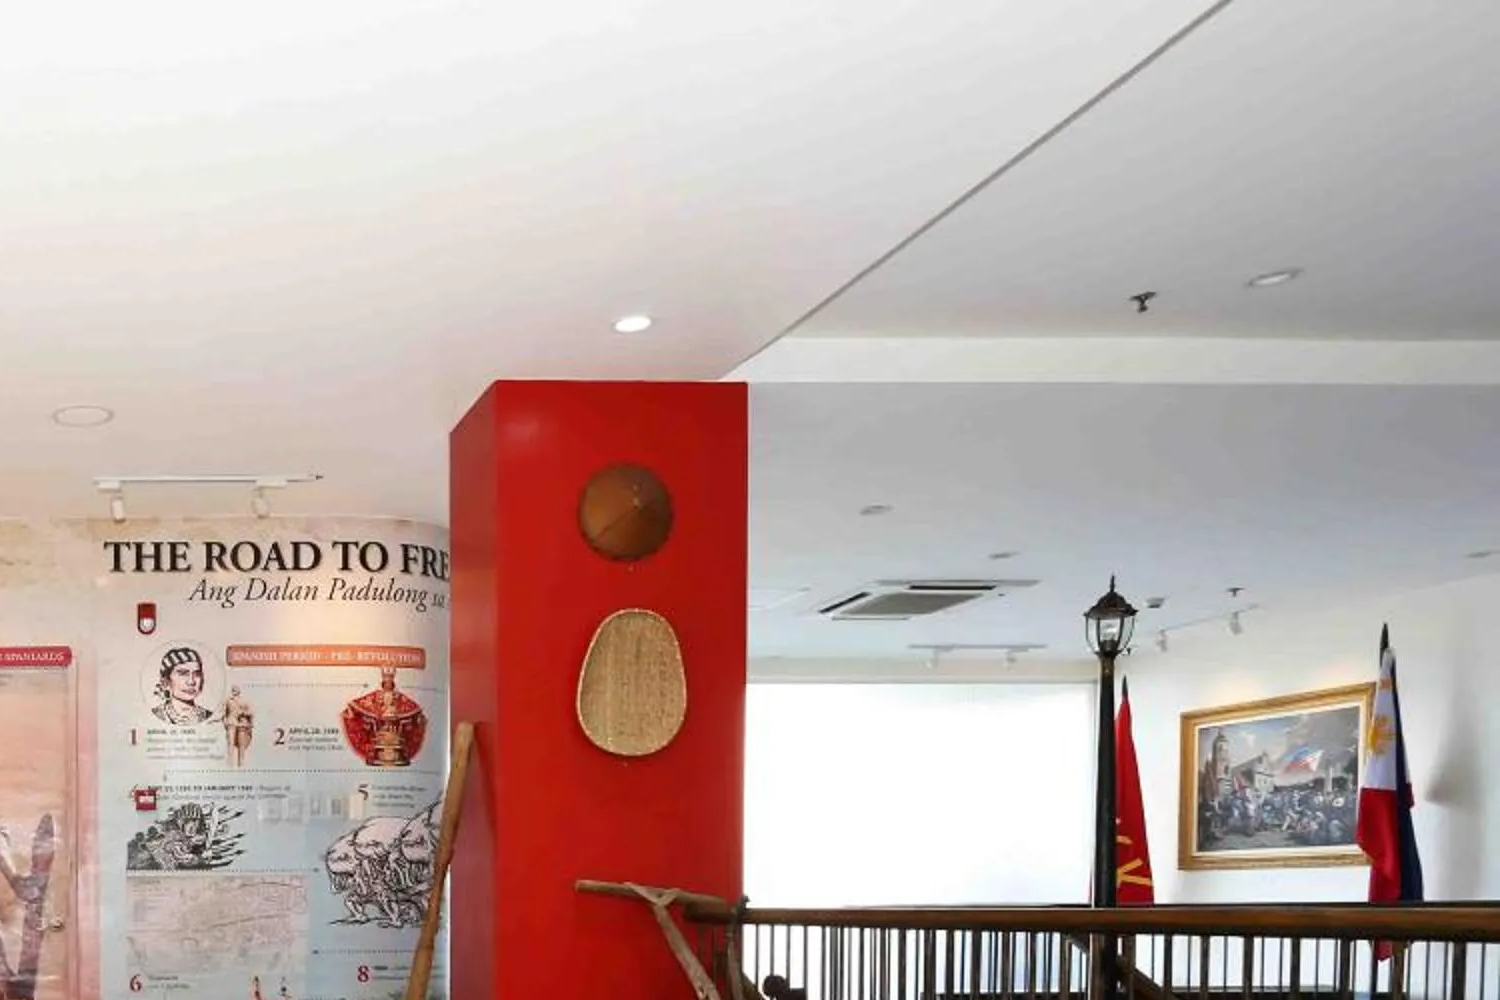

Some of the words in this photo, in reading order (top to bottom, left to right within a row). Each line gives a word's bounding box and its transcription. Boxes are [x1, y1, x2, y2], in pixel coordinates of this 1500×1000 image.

[103, 541, 192, 573] THE
[203, 541, 323, 573] ROAD
[331, 541, 389, 573] TO
[188, 578, 237, 609] Ang
[244, 576, 319, 601] Dalan
[328, 576, 428, 613] Padulong
[131, 729, 137, 745] 1
[274, 728, 285, 745] 2
[358, 784, 369, 800] 5
[357, 965, 369, 982] 8
[130, 974, 142, 992] 6
